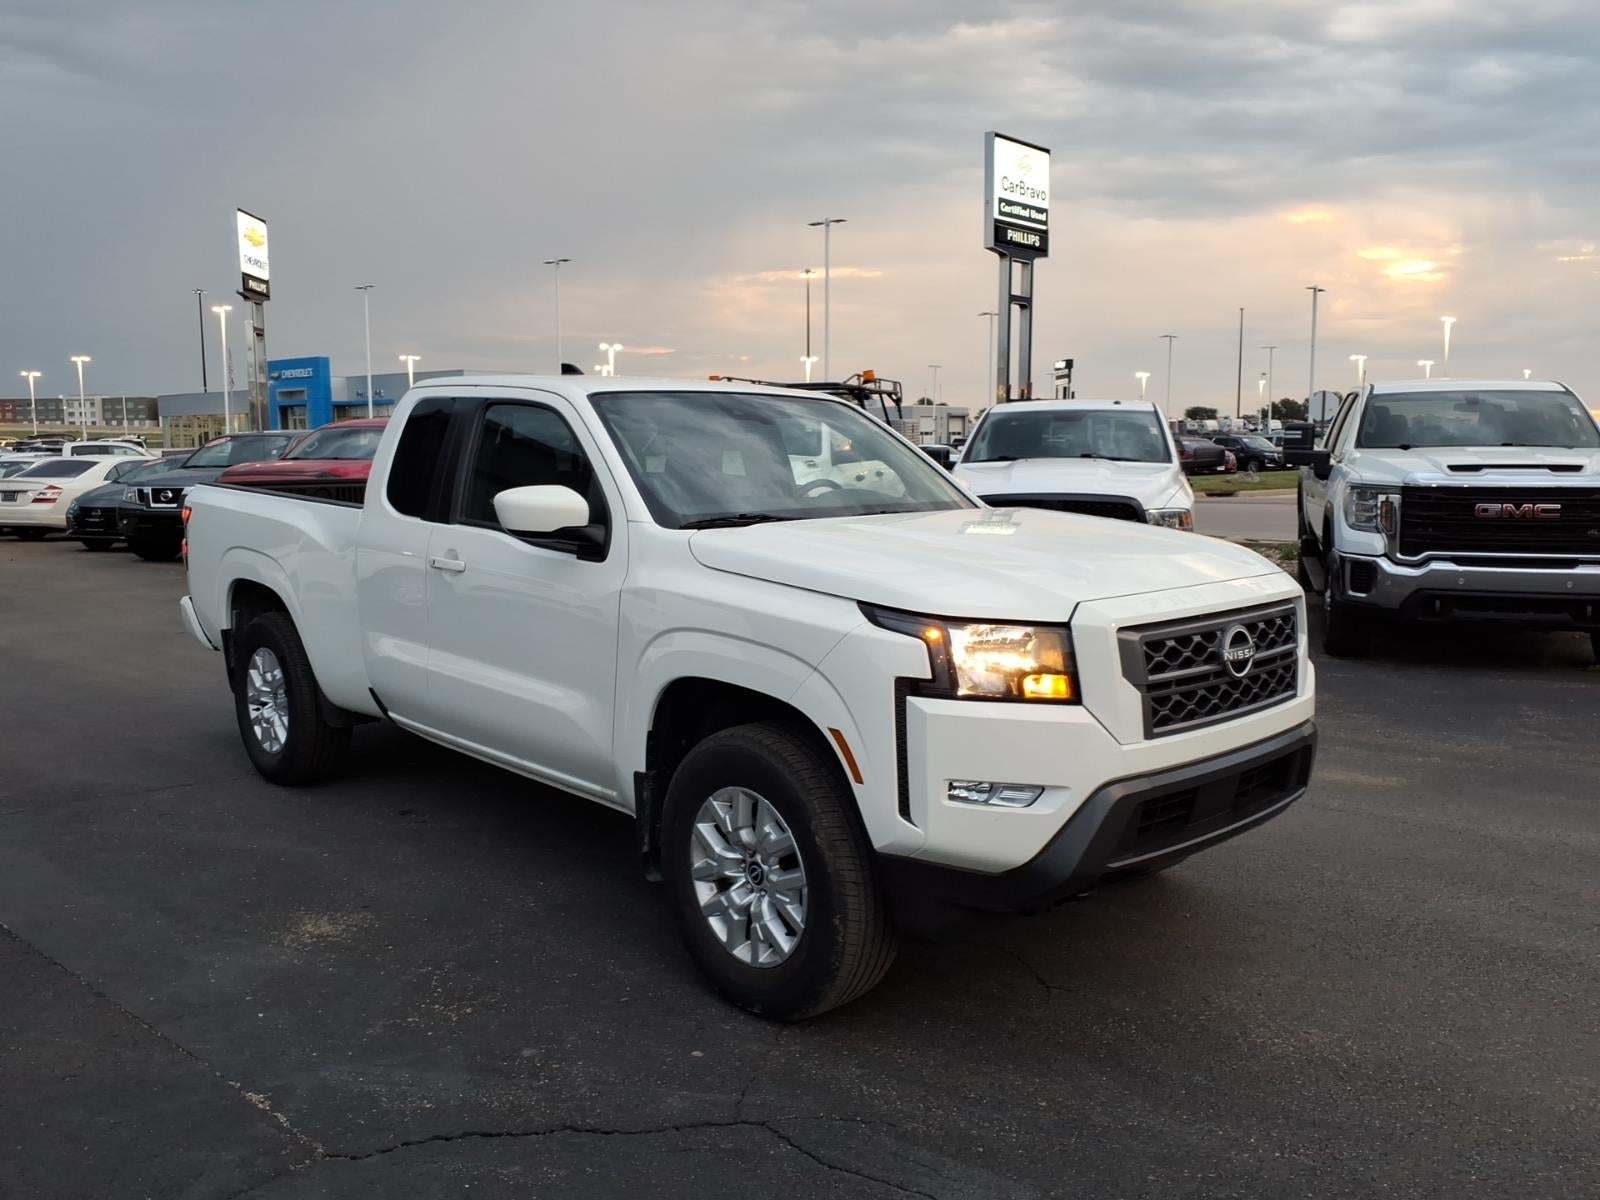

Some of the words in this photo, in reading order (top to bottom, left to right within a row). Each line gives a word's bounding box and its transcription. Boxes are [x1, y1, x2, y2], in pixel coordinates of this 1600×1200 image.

[1002, 176, 1046, 200] CarBravo
[1007, 229, 1040, 247] PHILLIPS
[1475, 503, 1561, 518] GMC
